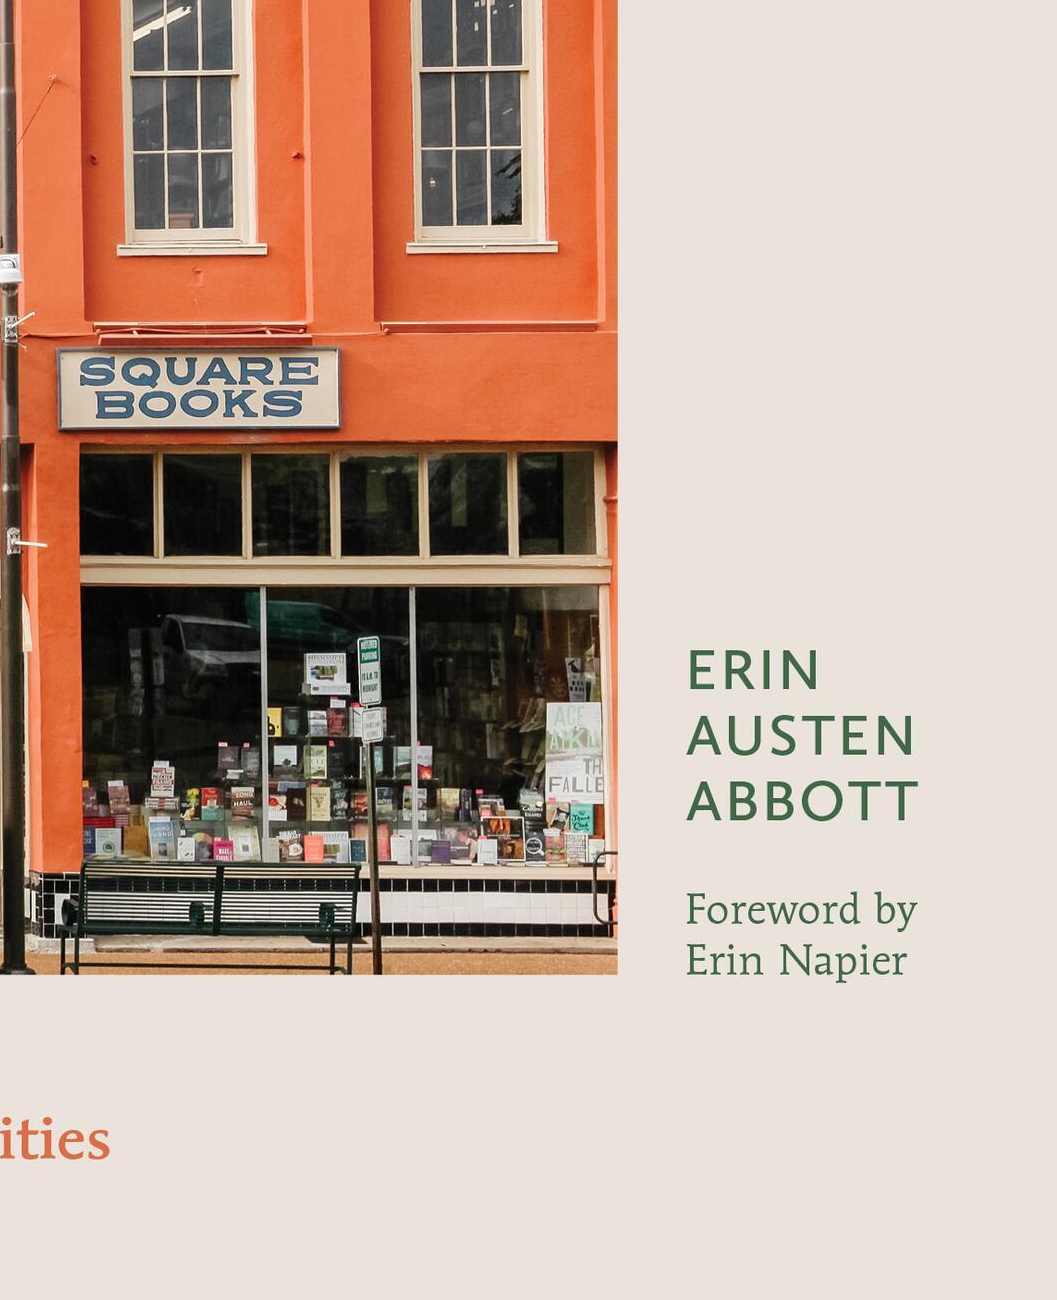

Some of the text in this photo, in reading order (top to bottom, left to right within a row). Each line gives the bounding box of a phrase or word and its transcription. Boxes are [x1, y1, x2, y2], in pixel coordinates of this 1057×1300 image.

[79, 356, 319, 388] SQUARE
[95, 389, 303, 419] BOOKS
[554, 704, 584, 727] ACE
[549, 776, 604, 793] FALLE
[233, 799, 253, 807] HAUL
[235, 791, 254, 799] LONG
